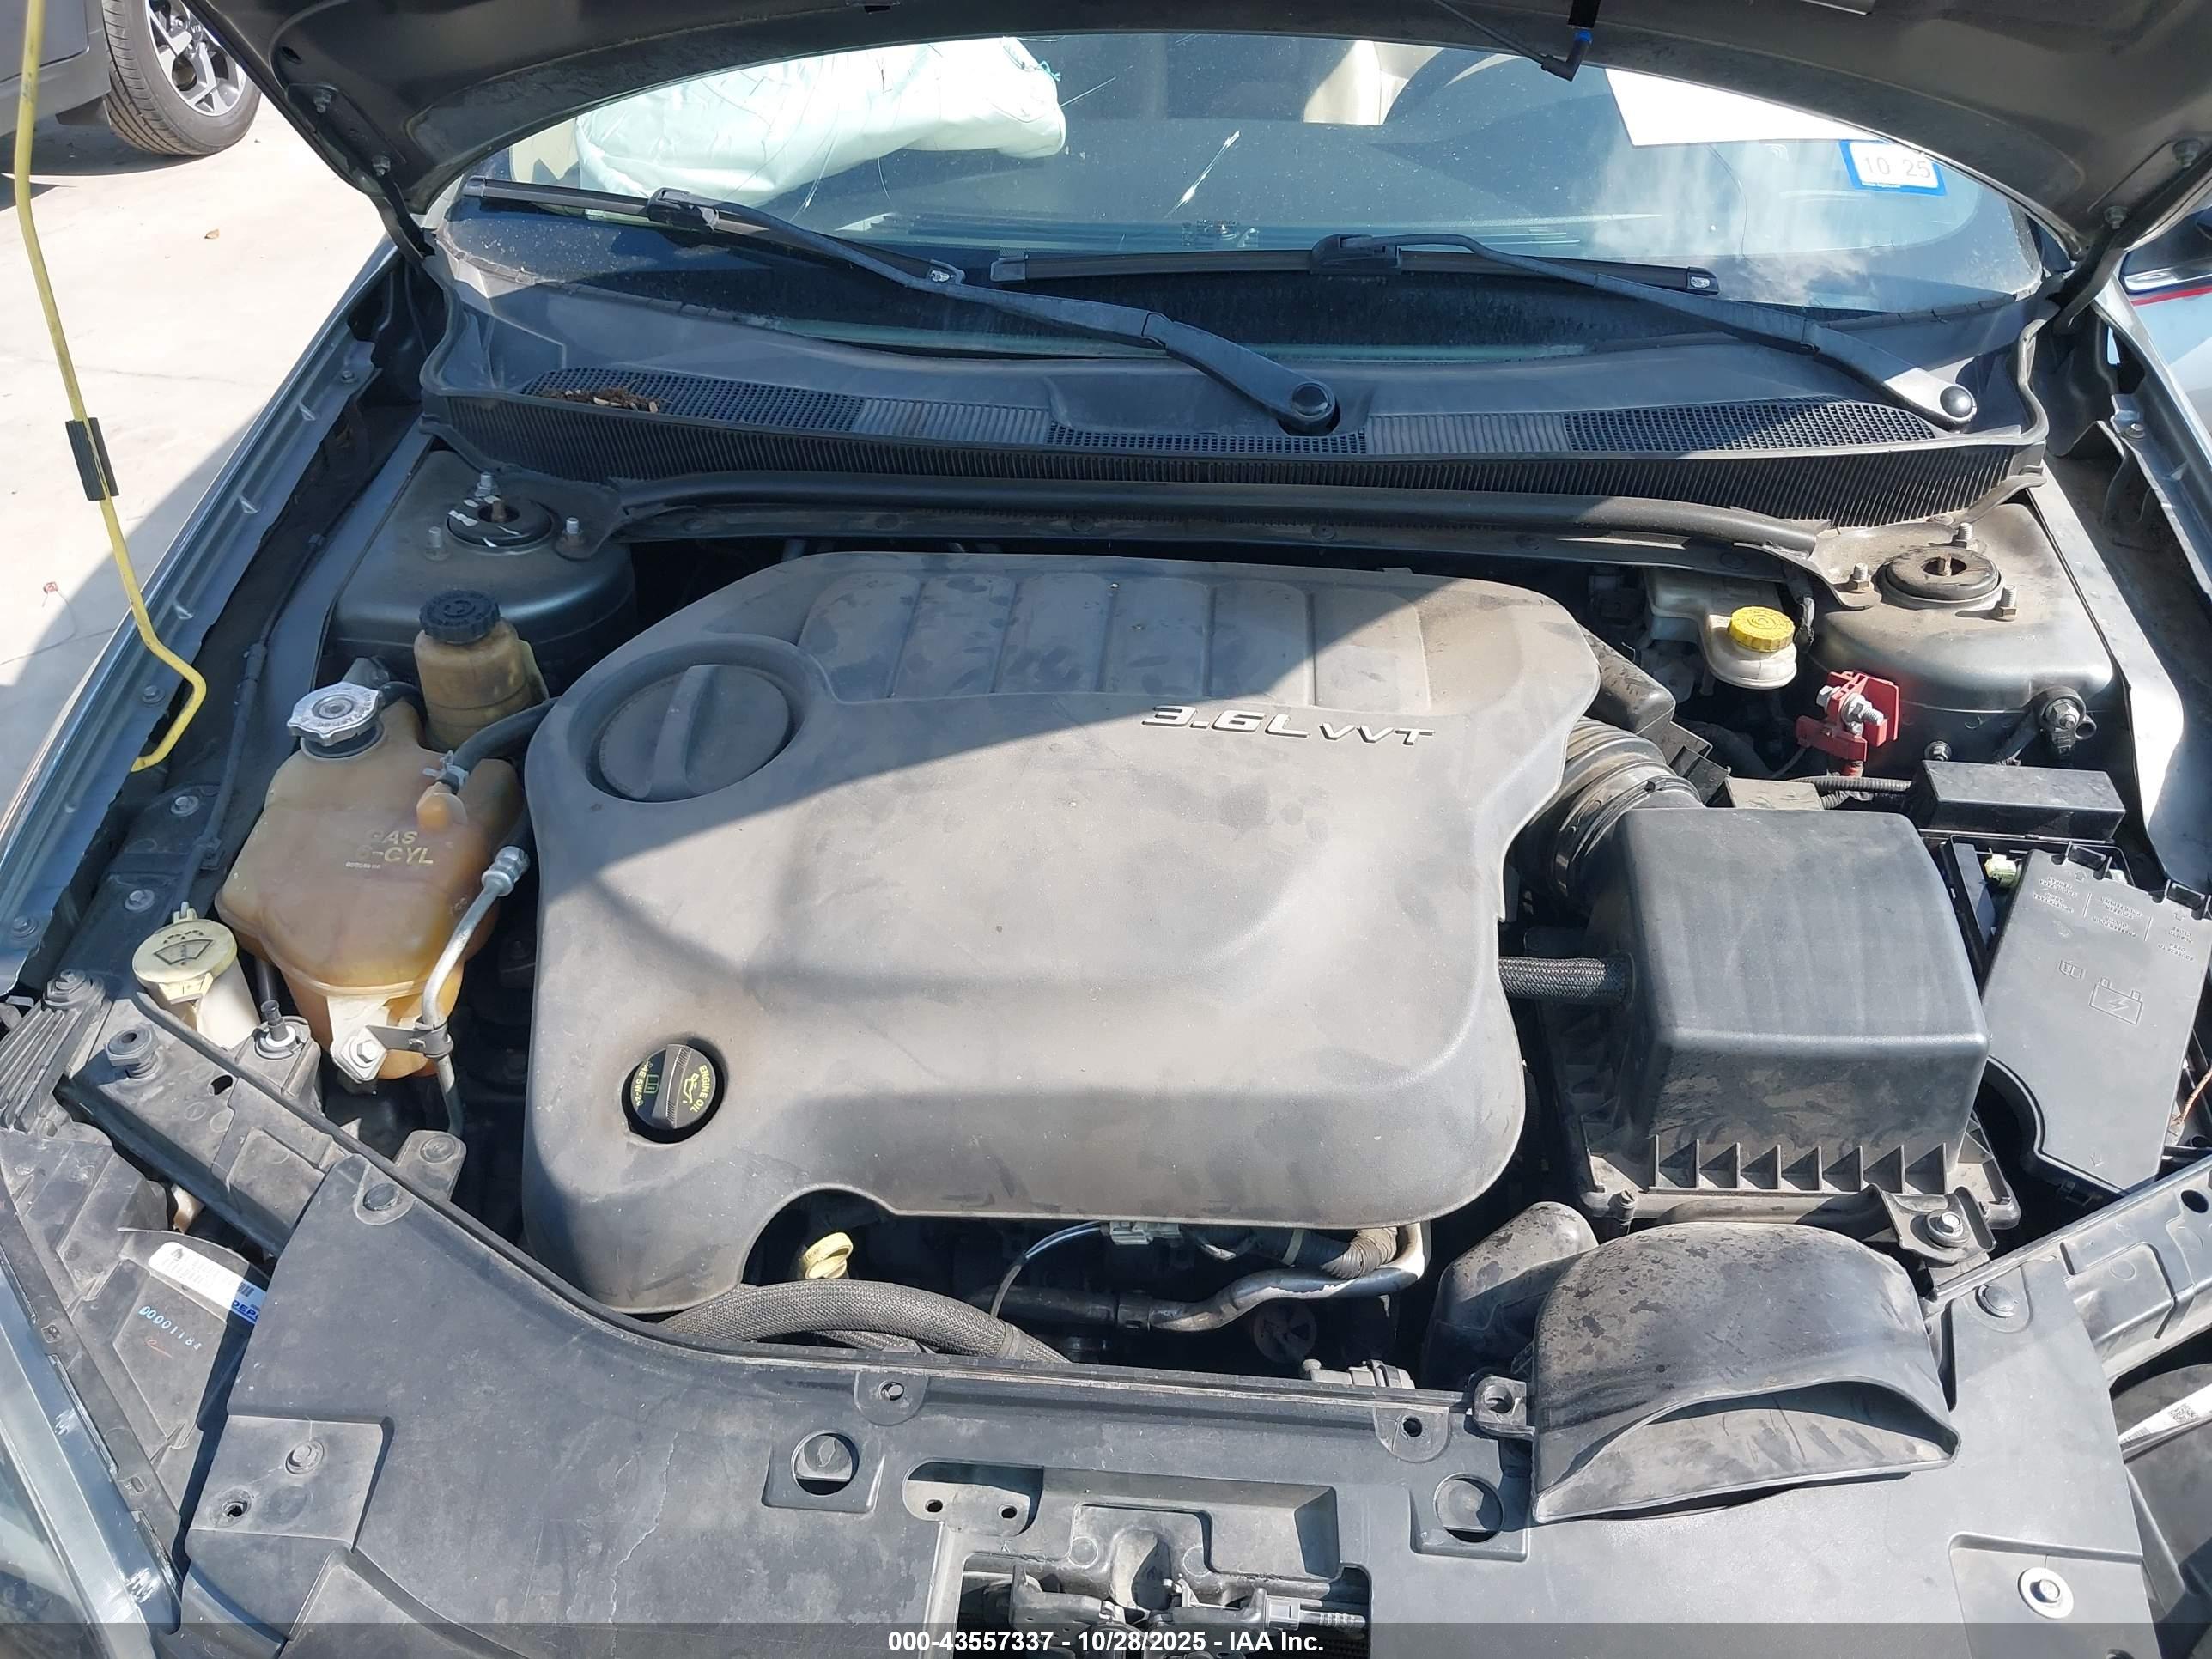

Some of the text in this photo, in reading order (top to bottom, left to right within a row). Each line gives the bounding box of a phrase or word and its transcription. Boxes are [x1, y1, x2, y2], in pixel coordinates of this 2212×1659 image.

[1864, 157, 1931, 179] 10 25
[1140, 704, 1436, 746] 3.6L VVT
[690, 1065, 711, 1114] ENGINE OIL
[232, 1299, 259, 1320] DEP
